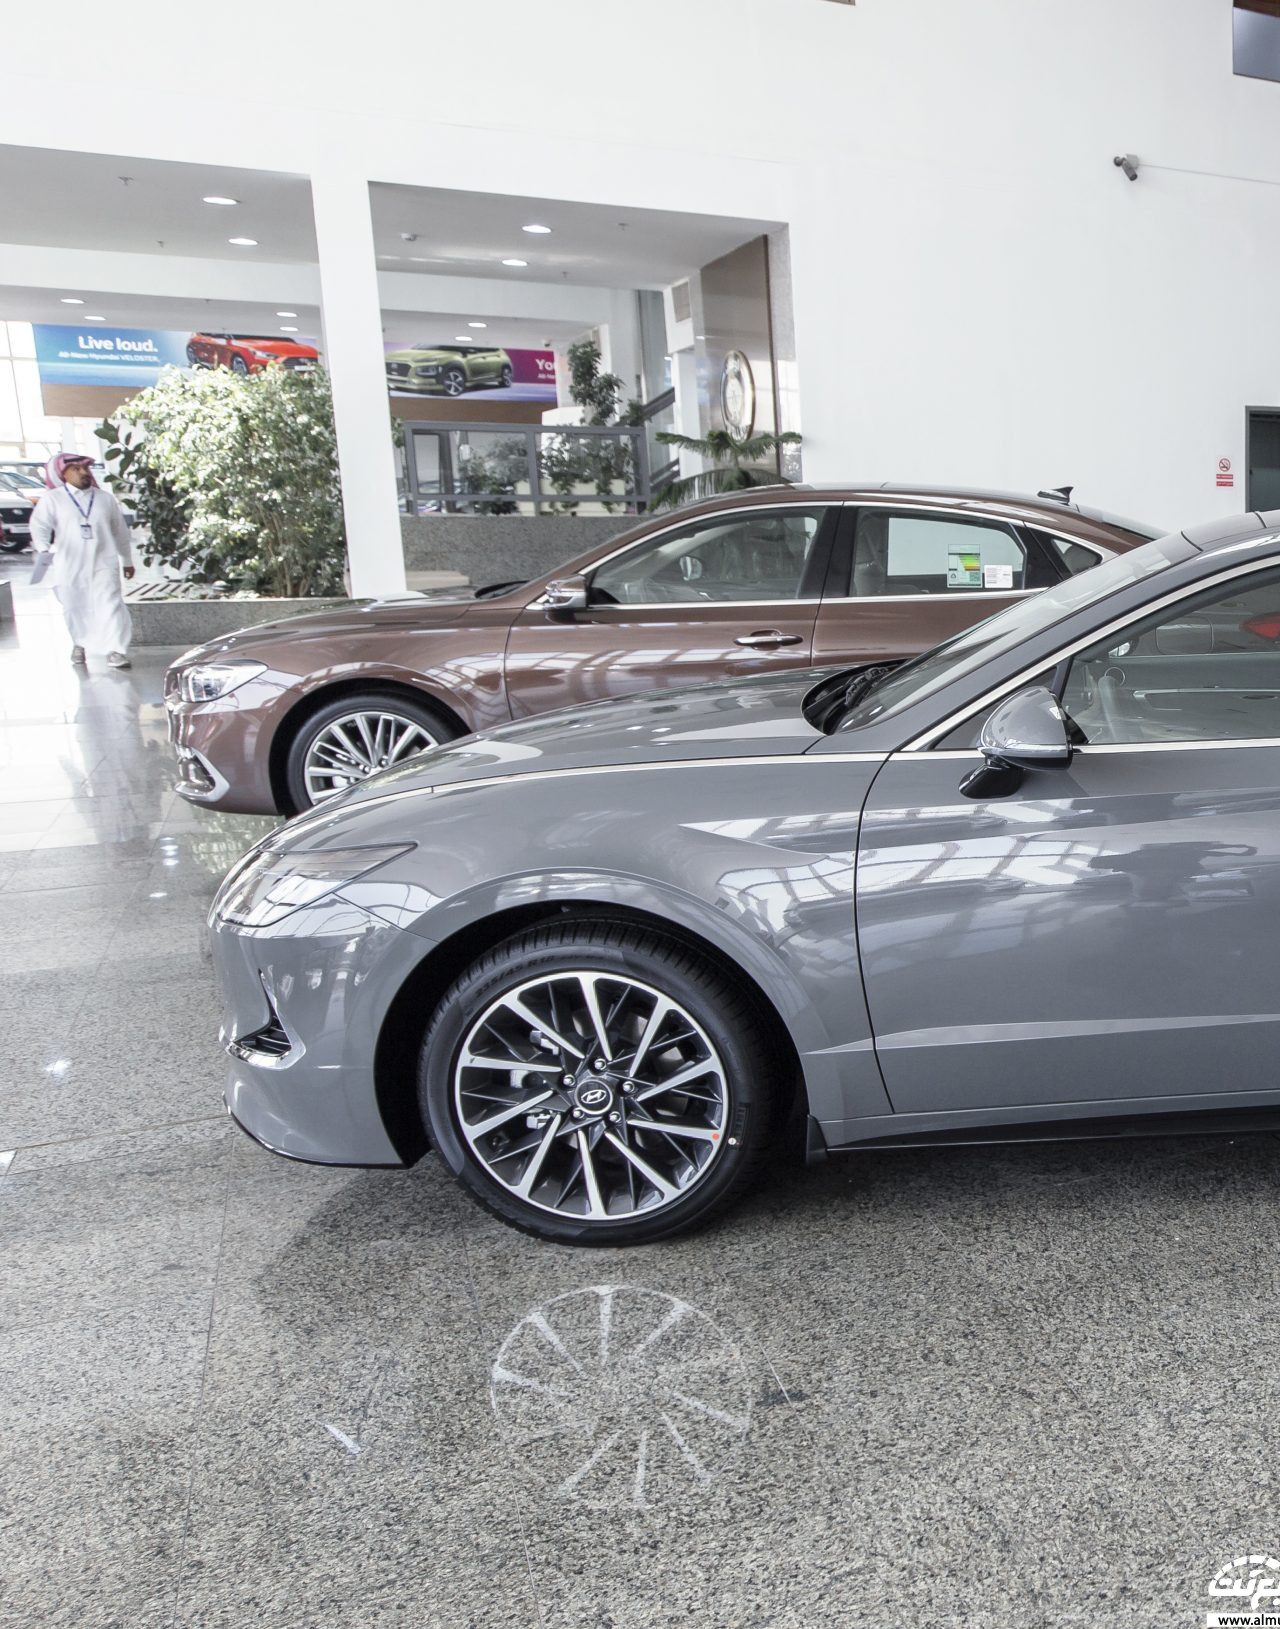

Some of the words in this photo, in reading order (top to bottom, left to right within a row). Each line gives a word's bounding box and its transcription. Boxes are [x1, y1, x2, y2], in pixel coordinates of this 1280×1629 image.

[78, 335, 114, 350] Live
[115, 337, 158, 352] loud.
[536, 358, 555, 371] Yo
